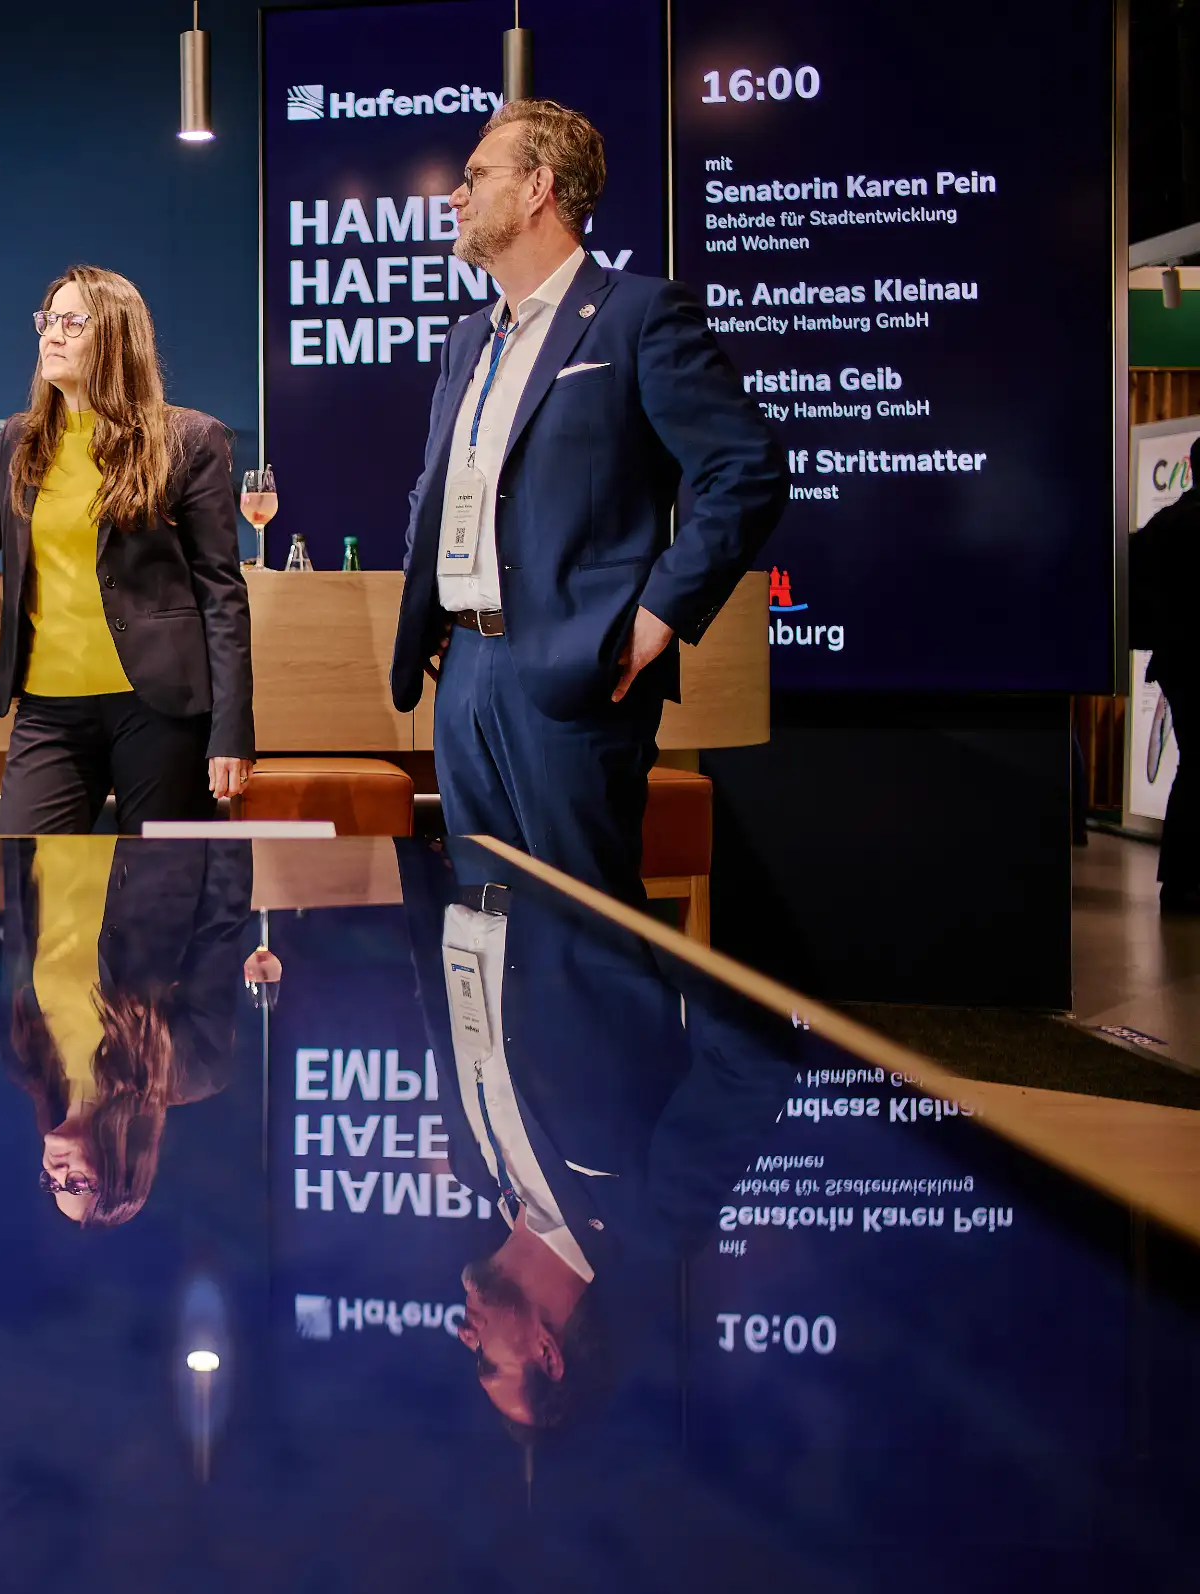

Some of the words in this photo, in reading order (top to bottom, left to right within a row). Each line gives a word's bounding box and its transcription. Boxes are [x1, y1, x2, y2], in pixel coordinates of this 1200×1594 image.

[701, 66, 820, 104] 16:00
[705, 156, 733, 171] mit
[705, 177, 838, 203] Senatorin
[847, 175, 927, 198] Karen
[936, 171, 997, 195] Pein
[705, 213, 776, 229] Behörde
[780, 211, 805, 227] für
[809, 207, 958, 226] Stadtentwicklung
[705, 236, 737, 252] und
[742, 234, 809, 251] Wohnen
[706, 284, 743, 307] Dr.
[751, 282, 866, 306] Andreas
[874, 278, 978, 303] Kleinau
[707, 315, 789, 335] HafenCity
[793, 314, 871, 333] Hamburg
[876, 312, 929, 329] GmbH
[290, 315, 468, 365] EMPF
[743, 369, 831, 393] ristina
[839, 366, 902, 391] Geib
[794, 402, 871, 420] Hamburg
[877, 400, 930, 417] GmbH
[816, 449, 987, 473] Strittmatter
[789, 484, 839, 500] Invest
[768, 618, 844, 652] burg
